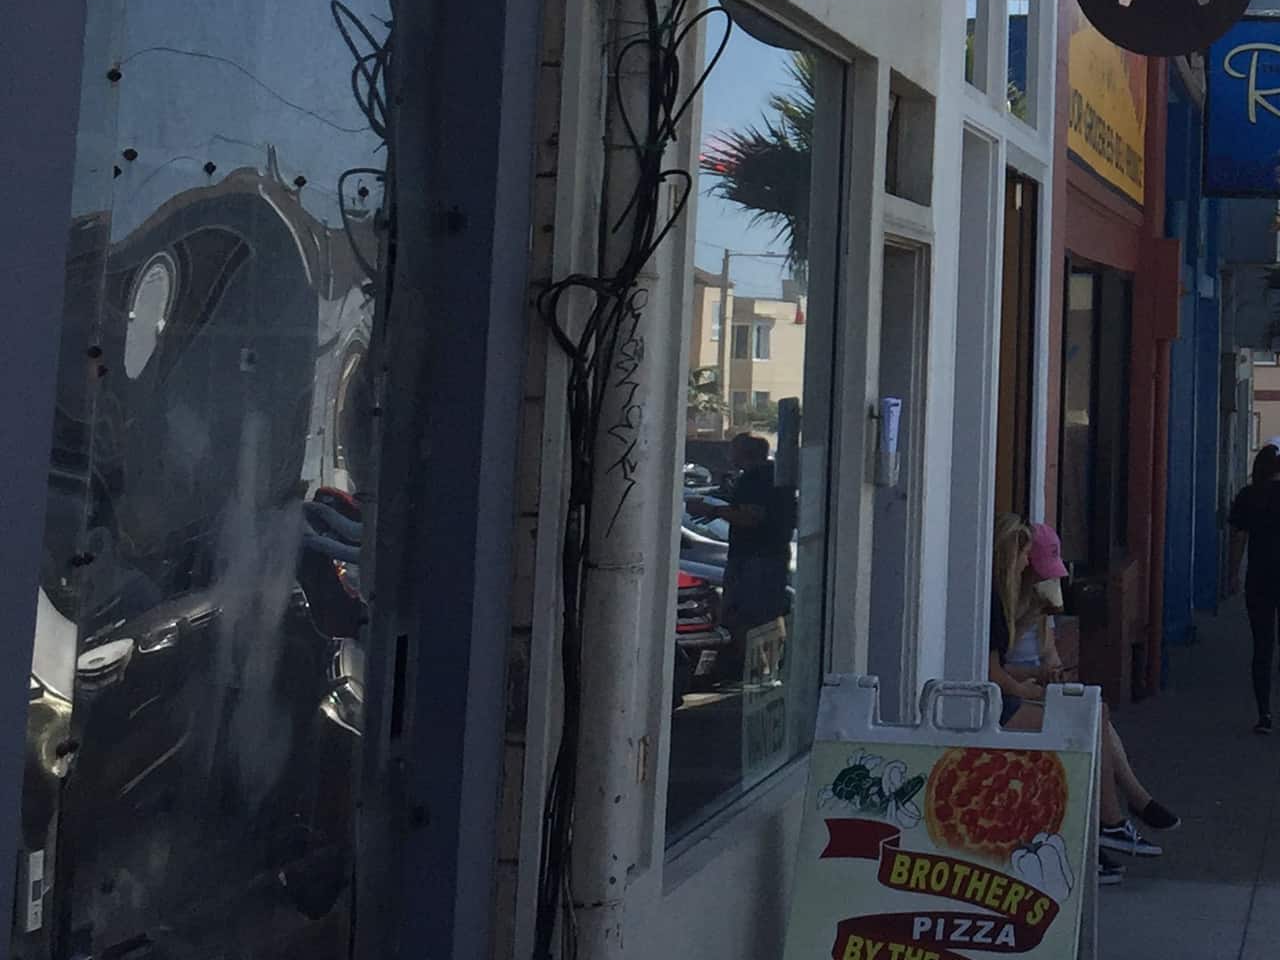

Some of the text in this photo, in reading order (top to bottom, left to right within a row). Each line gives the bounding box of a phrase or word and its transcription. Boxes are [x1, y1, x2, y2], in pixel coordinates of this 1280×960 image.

[890, 854, 1050, 926] BROTHER'S
[843, 934, 882, 960] BY
[912, 916, 1016, 947] PIZZA
